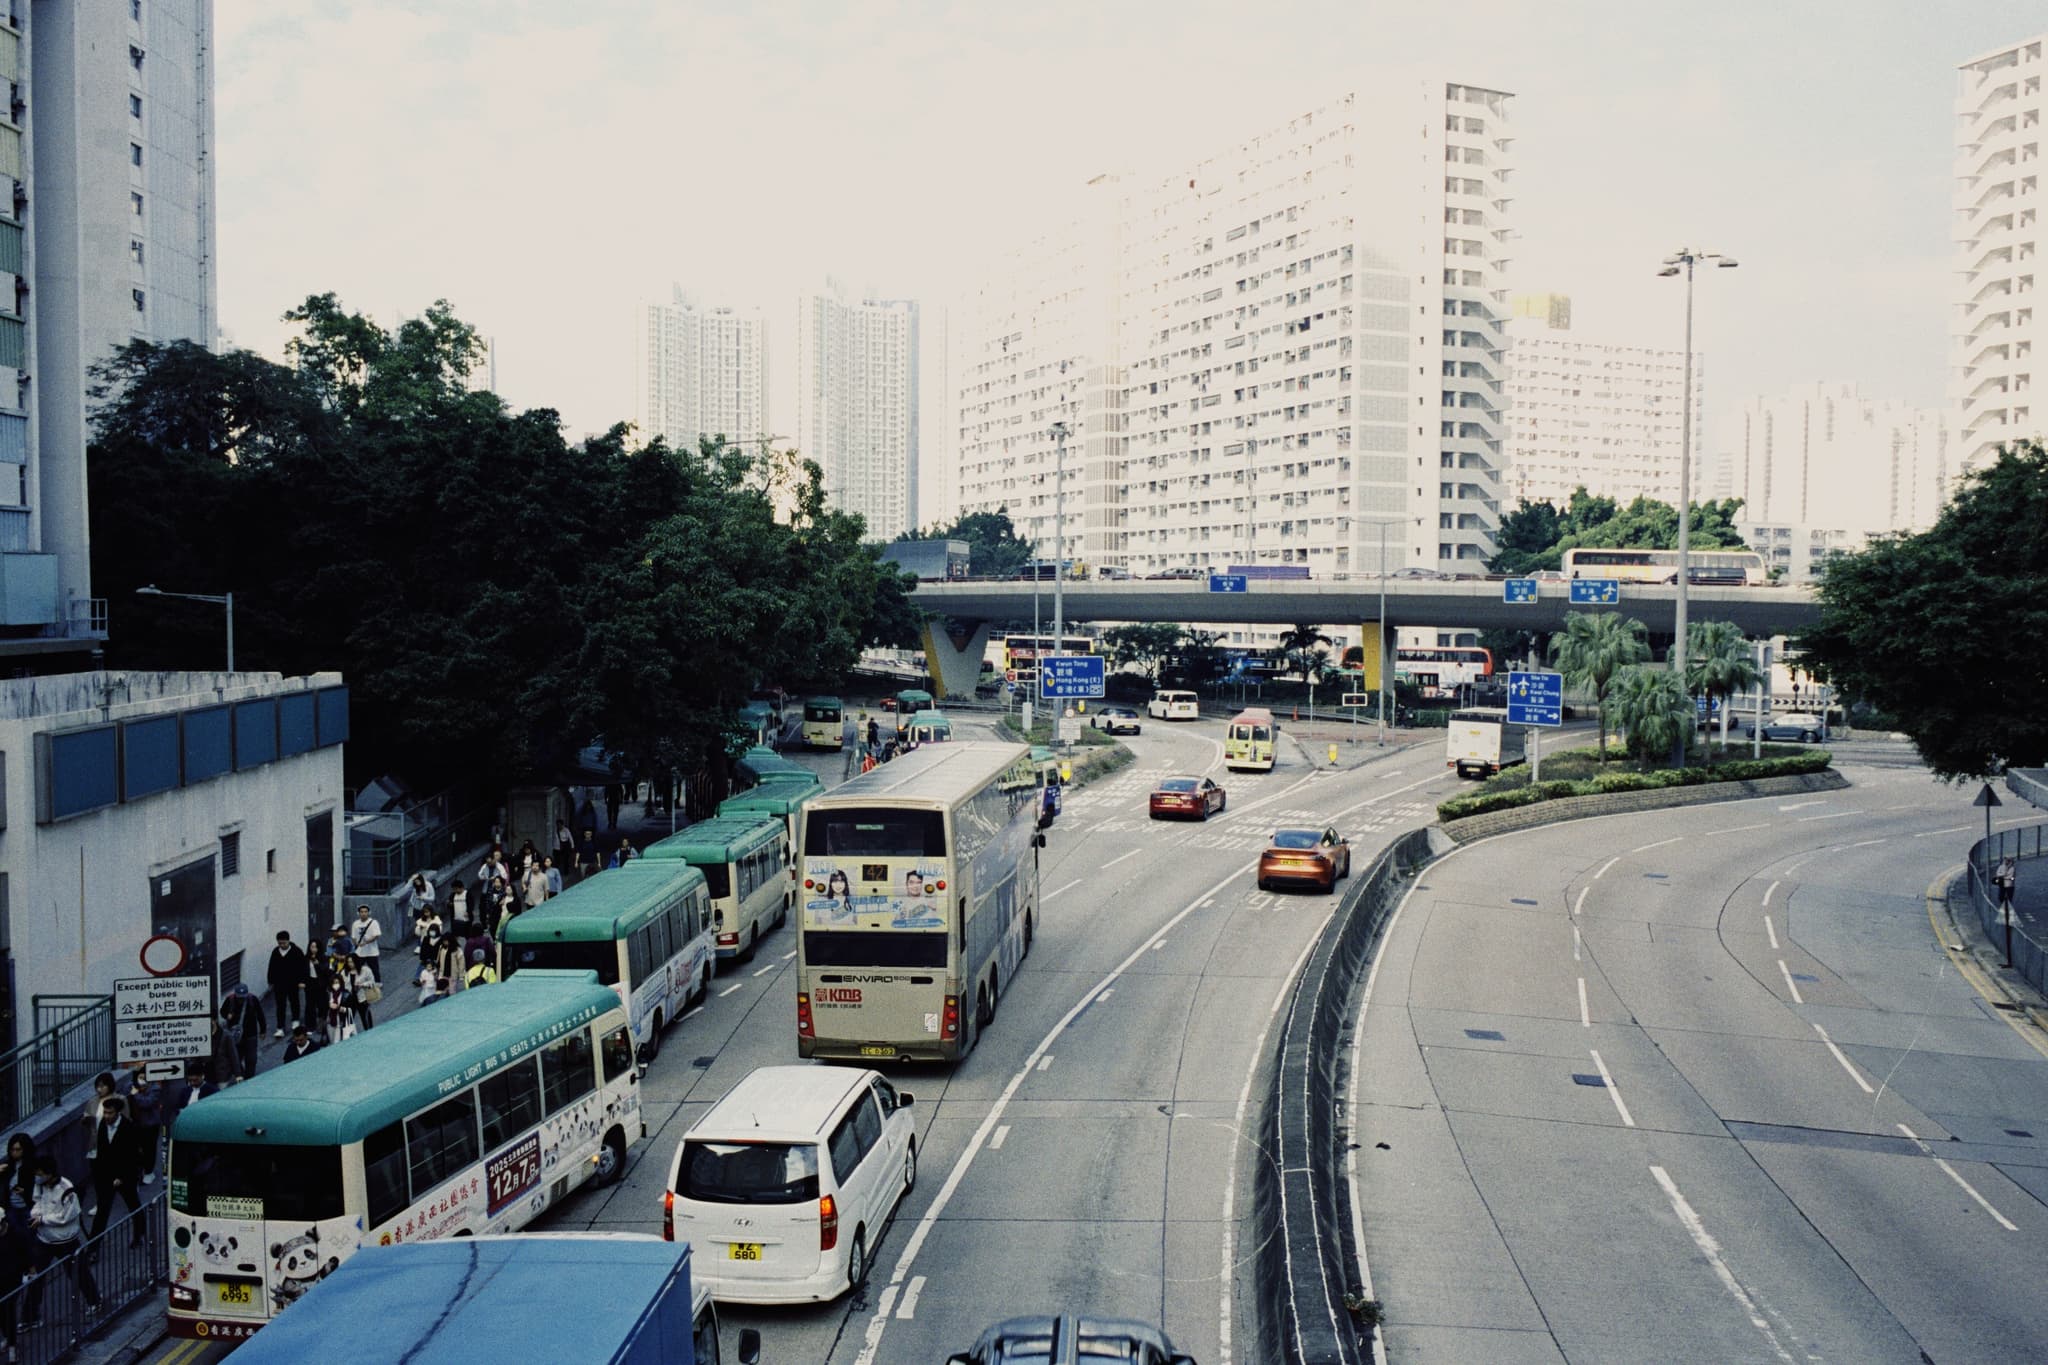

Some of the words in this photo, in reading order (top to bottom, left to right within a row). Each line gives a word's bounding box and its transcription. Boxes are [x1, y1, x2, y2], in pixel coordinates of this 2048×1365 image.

[1073, 660, 1088, 668] Tong
[117, 983, 151, 991] Except
[153, 981, 183, 990] public
[185, 979, 208, 988] light
[149, 991, 177, 999] buses
[829, 988, 862, 1002] KMB
[121, 1000, 205, 1015] 公共小巴例外
[136, 1022, 165, 1030] Except
[167, 1021, 192, 1029] public
[141, 1030, 161, 1038] light
[120, 1037, 168, 1048] (scheduled
[170, 1035, 208, 1043] services)
[437, 1074, 462, 1094] PUBLIC
[463, 1062, 483, 1081] LIGHT
[485, 1056, 498, 1070] BUS
[509, 1039, 529, 1057] SEATS
[221, 1291, 249, 1302] 6993
